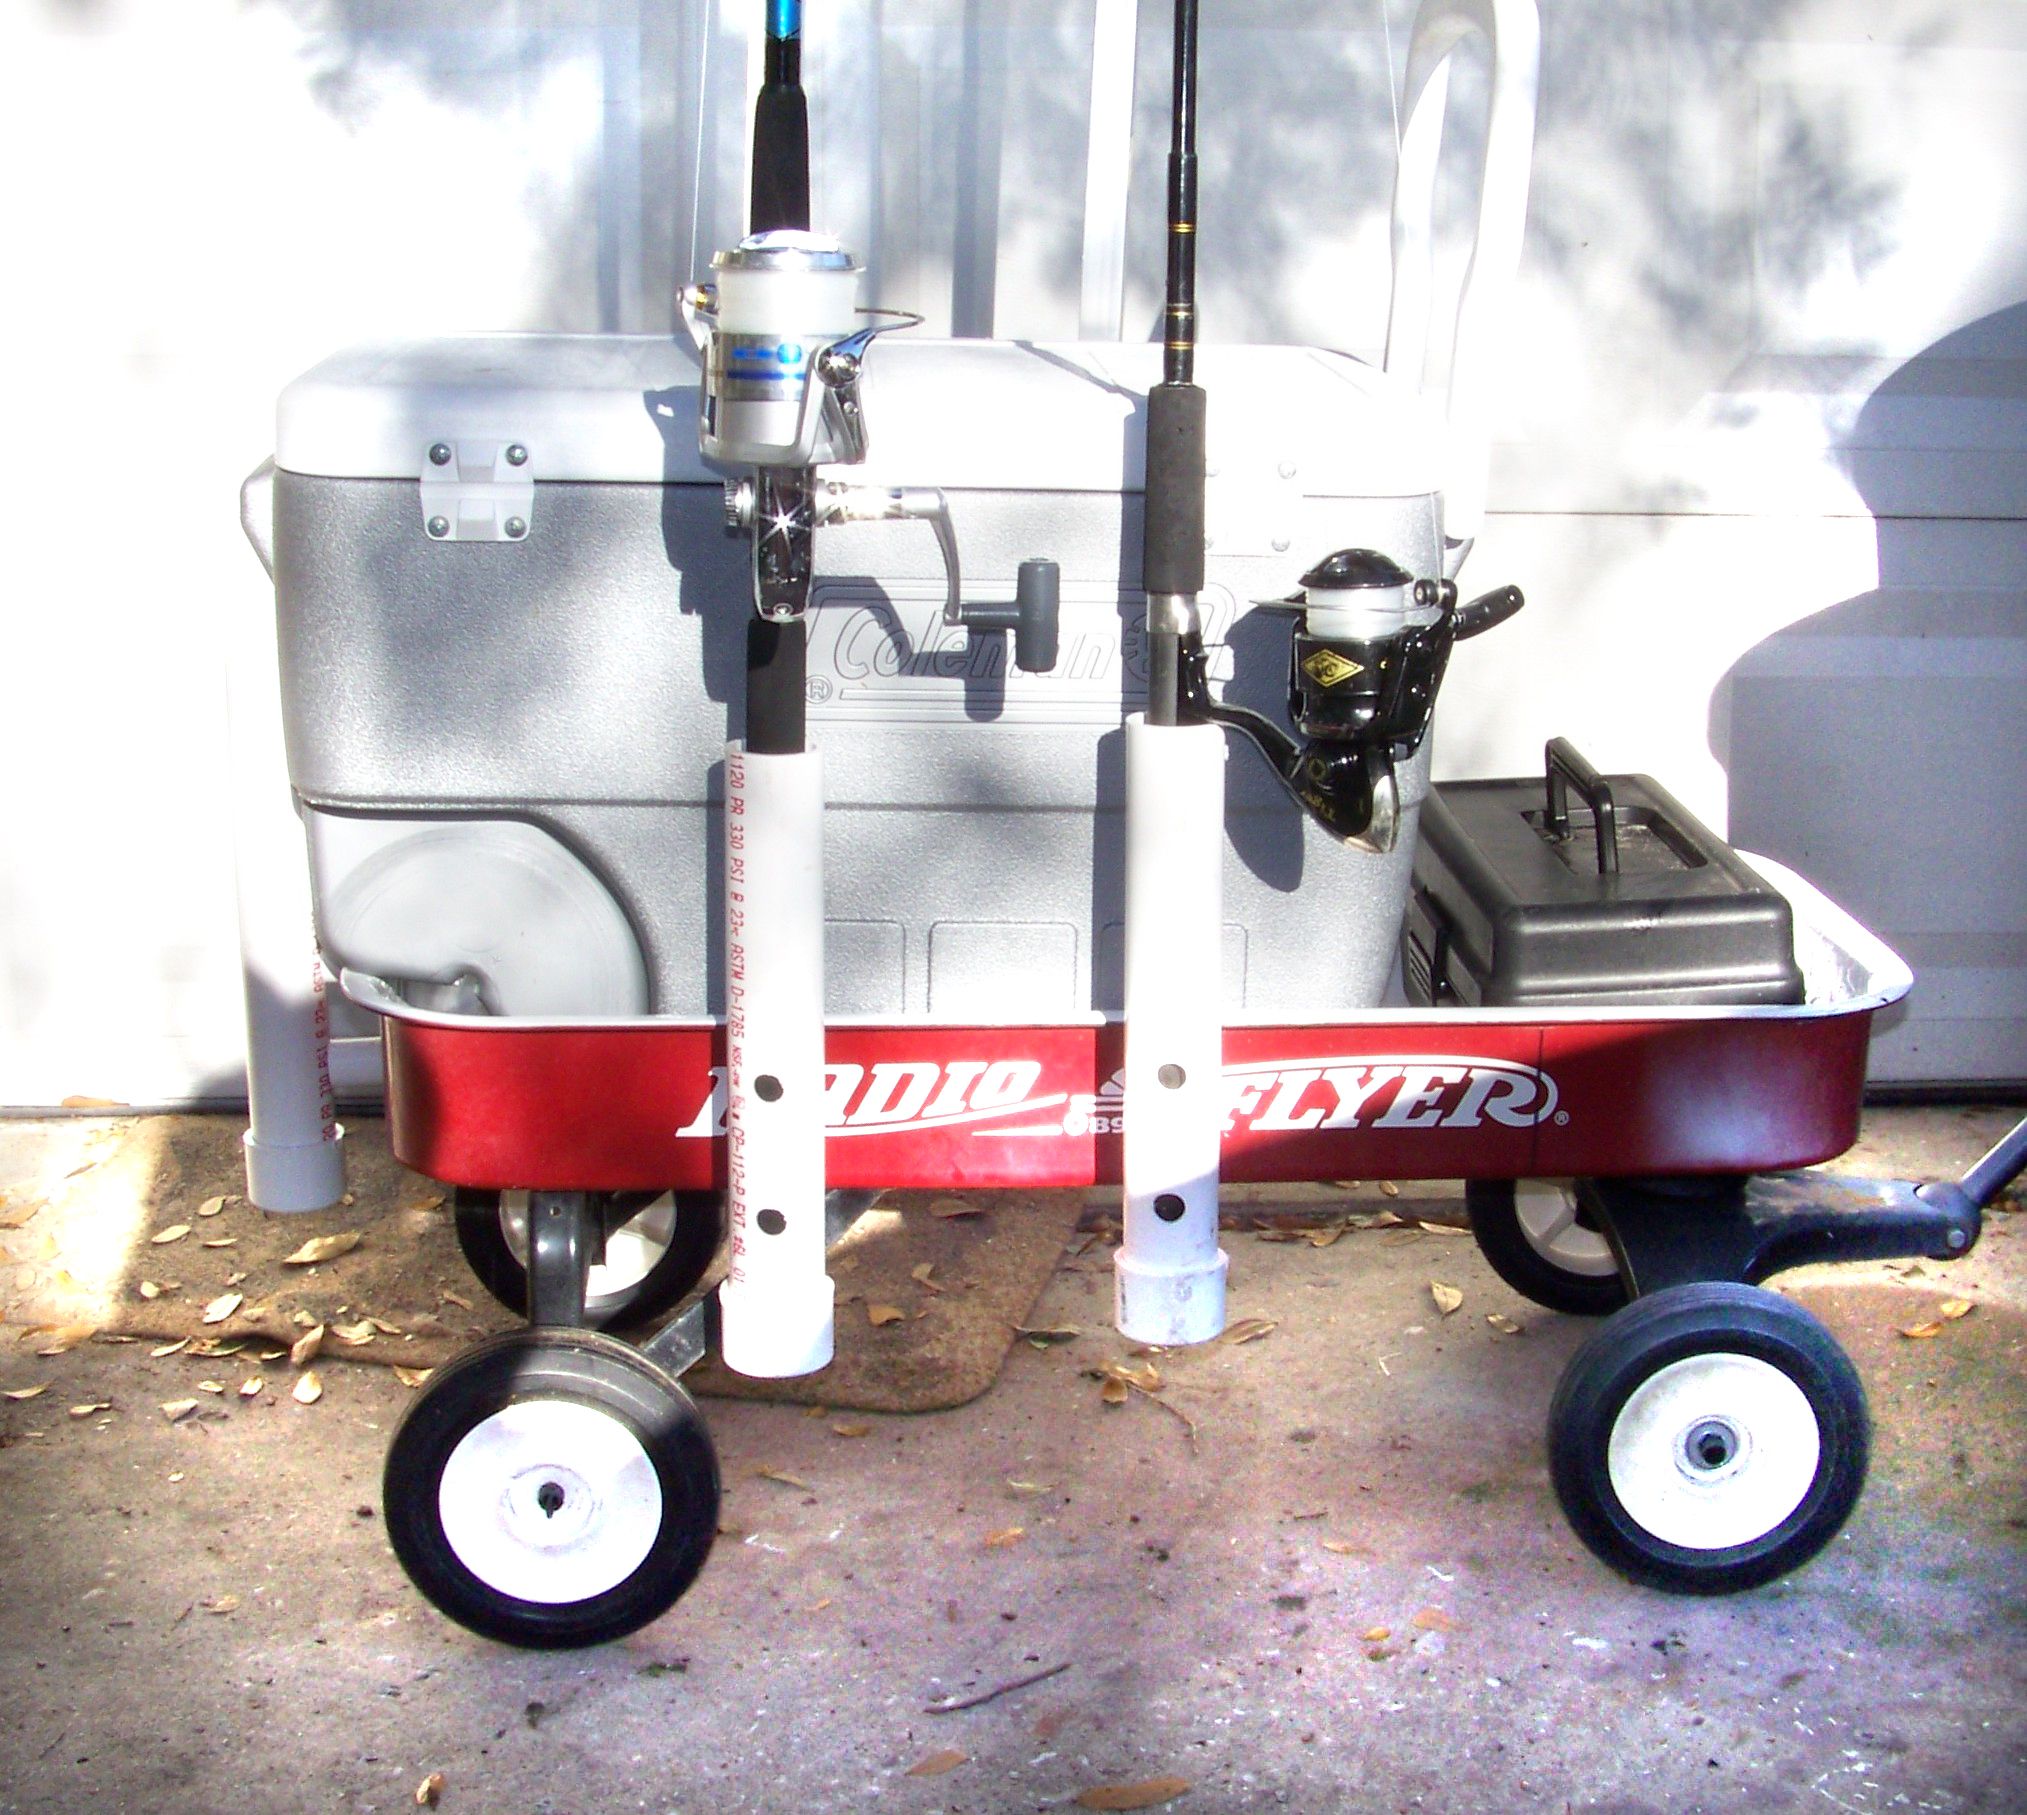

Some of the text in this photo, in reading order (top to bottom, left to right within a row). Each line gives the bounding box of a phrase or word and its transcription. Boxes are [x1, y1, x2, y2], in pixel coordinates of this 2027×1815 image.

[730, 795, 745, 817] PR
[730, 821, 745, 850] 330
[730, 856, 745, 885] PSI
[730, 942, 745, 981] ASTM
[1221, 1063, 1552, 1130] FLYER
